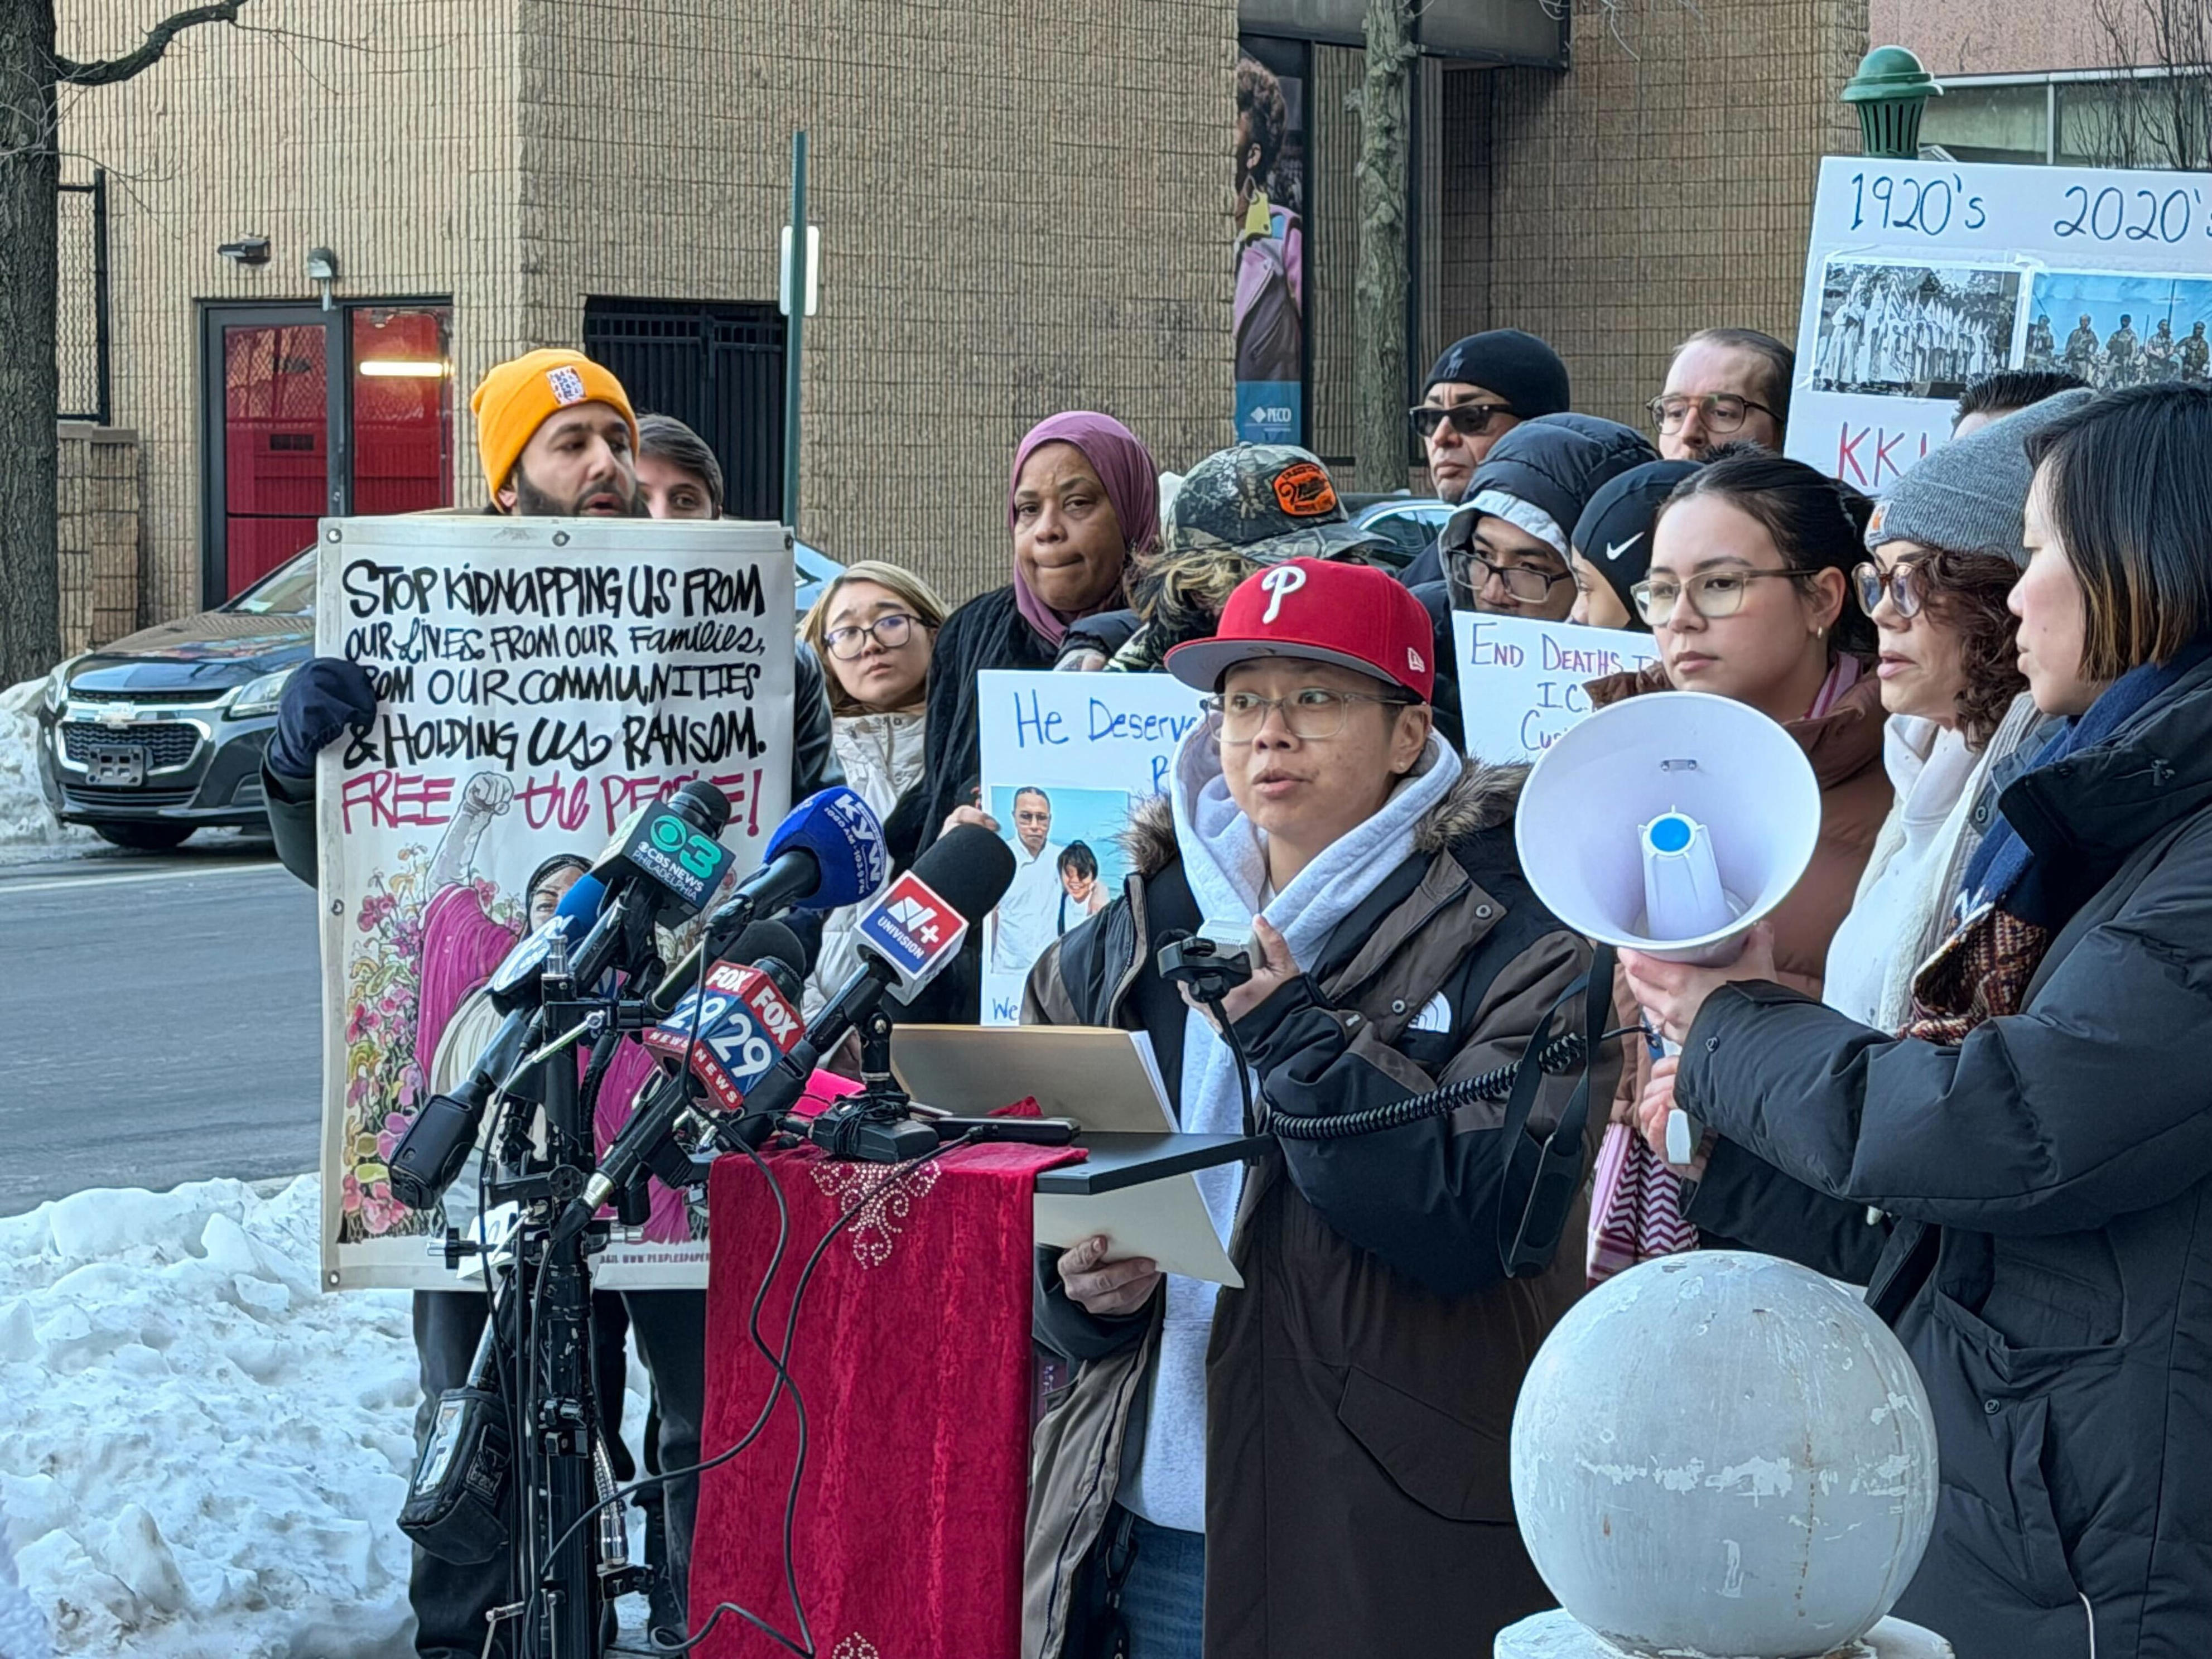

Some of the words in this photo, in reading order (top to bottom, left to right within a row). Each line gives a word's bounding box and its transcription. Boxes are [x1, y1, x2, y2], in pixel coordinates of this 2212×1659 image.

[1850, 173, 1986, 235] 1920's
[2054, 186, 2212, 243] 2020'
[1267, 408, 1291, 422] PECO
[343, 559, 437, 618] STOP
[628, 565, 676, 618] US
[683, 563, 765, 617] FROM
[1261, 566, 1307, 624] P
[345, 621, 394, 662] OUR
[490, 624, 561, 663] FROM
[566, 624, 618, 658] OUR
[428, 667, 518, 705] OUR
[519, 662, 760, 706] COMMUNITIES
[622, 706, 766, 771] RANSOM.
[1014, 689, 1069, 748] He
[342, 770, 455, 834] FREE
[632, 850, 697, 901] PHILADELPHIA
[647, 848, 671, 869] CBS
[669, 860, 704, 892] NEWS
[679, 835, 722, 878] 3
[878, 916, 924, 959] UNIVISION
[705, 966, 754, 991] FOX
[751, 985, 799, 1045] FOX
[709, 1013, 772, 1077] 29
[695, 1049, 738, 1103] NEWS
